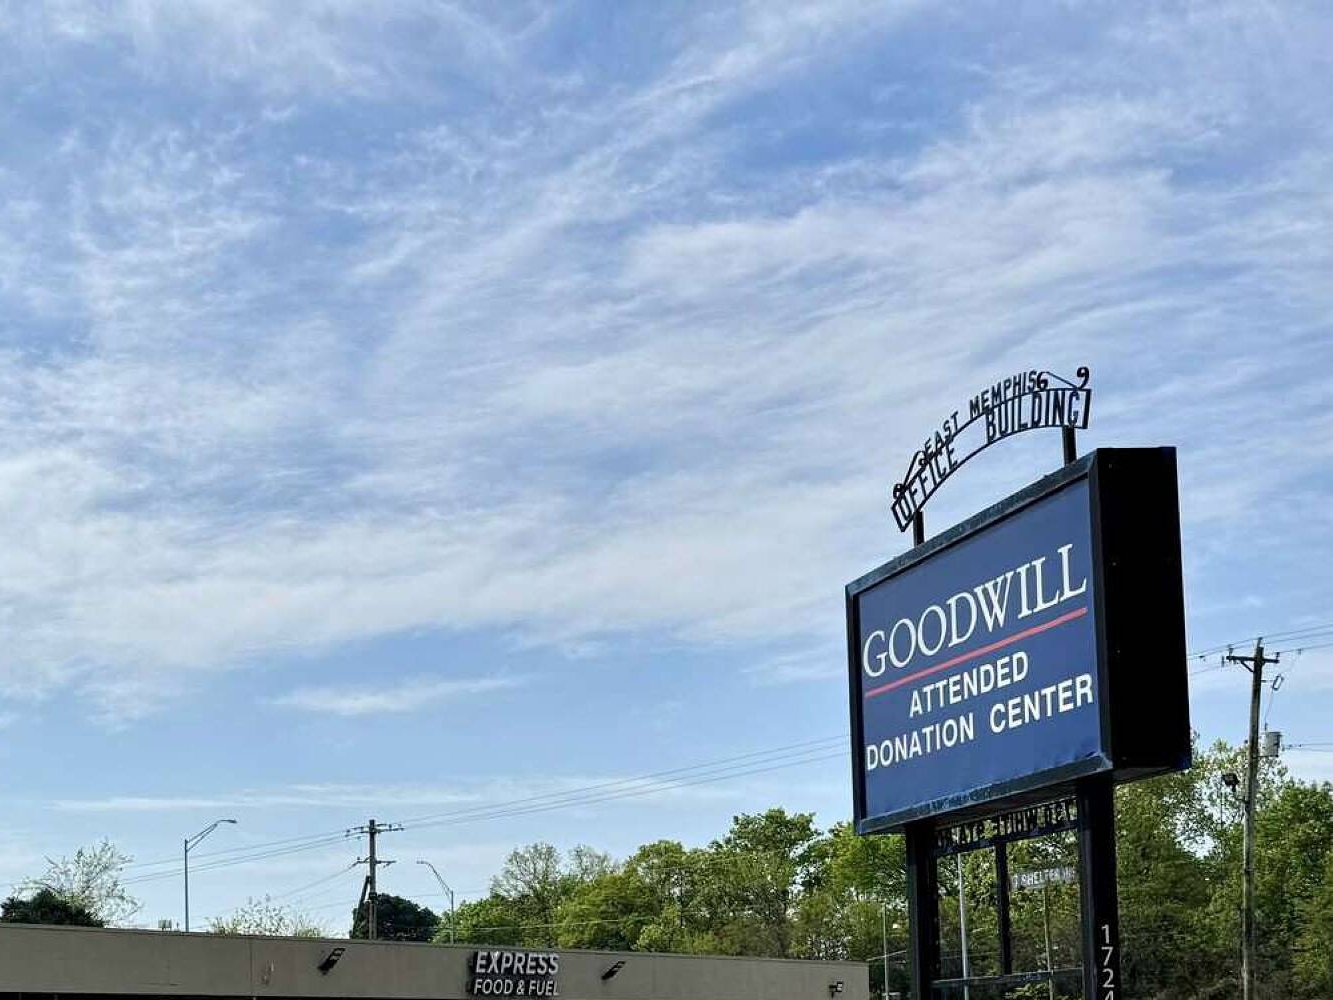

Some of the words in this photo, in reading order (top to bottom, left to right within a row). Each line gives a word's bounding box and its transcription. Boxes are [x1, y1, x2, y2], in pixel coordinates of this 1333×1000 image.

[897, 437, 959, 524] OFFICE
[985, 390, 1080, 444] BUILDING
[924, 411, 959, 460] EAST
[969, 370, 1038, 418] MEMPHIS
[863, 543, 1087, 678] GOODWILL
[866, 712, 975, 771] DONATION
[989, 674, 1094, 734] CENTER
[909, 651, 1029, 718] ATTENDED
[474, 979, 513, 995] FOOD
[516, 979, 525, 996] &
[528, 979, 559, 996] FUEL
[475, 950, 559, 975] EXPRESS
